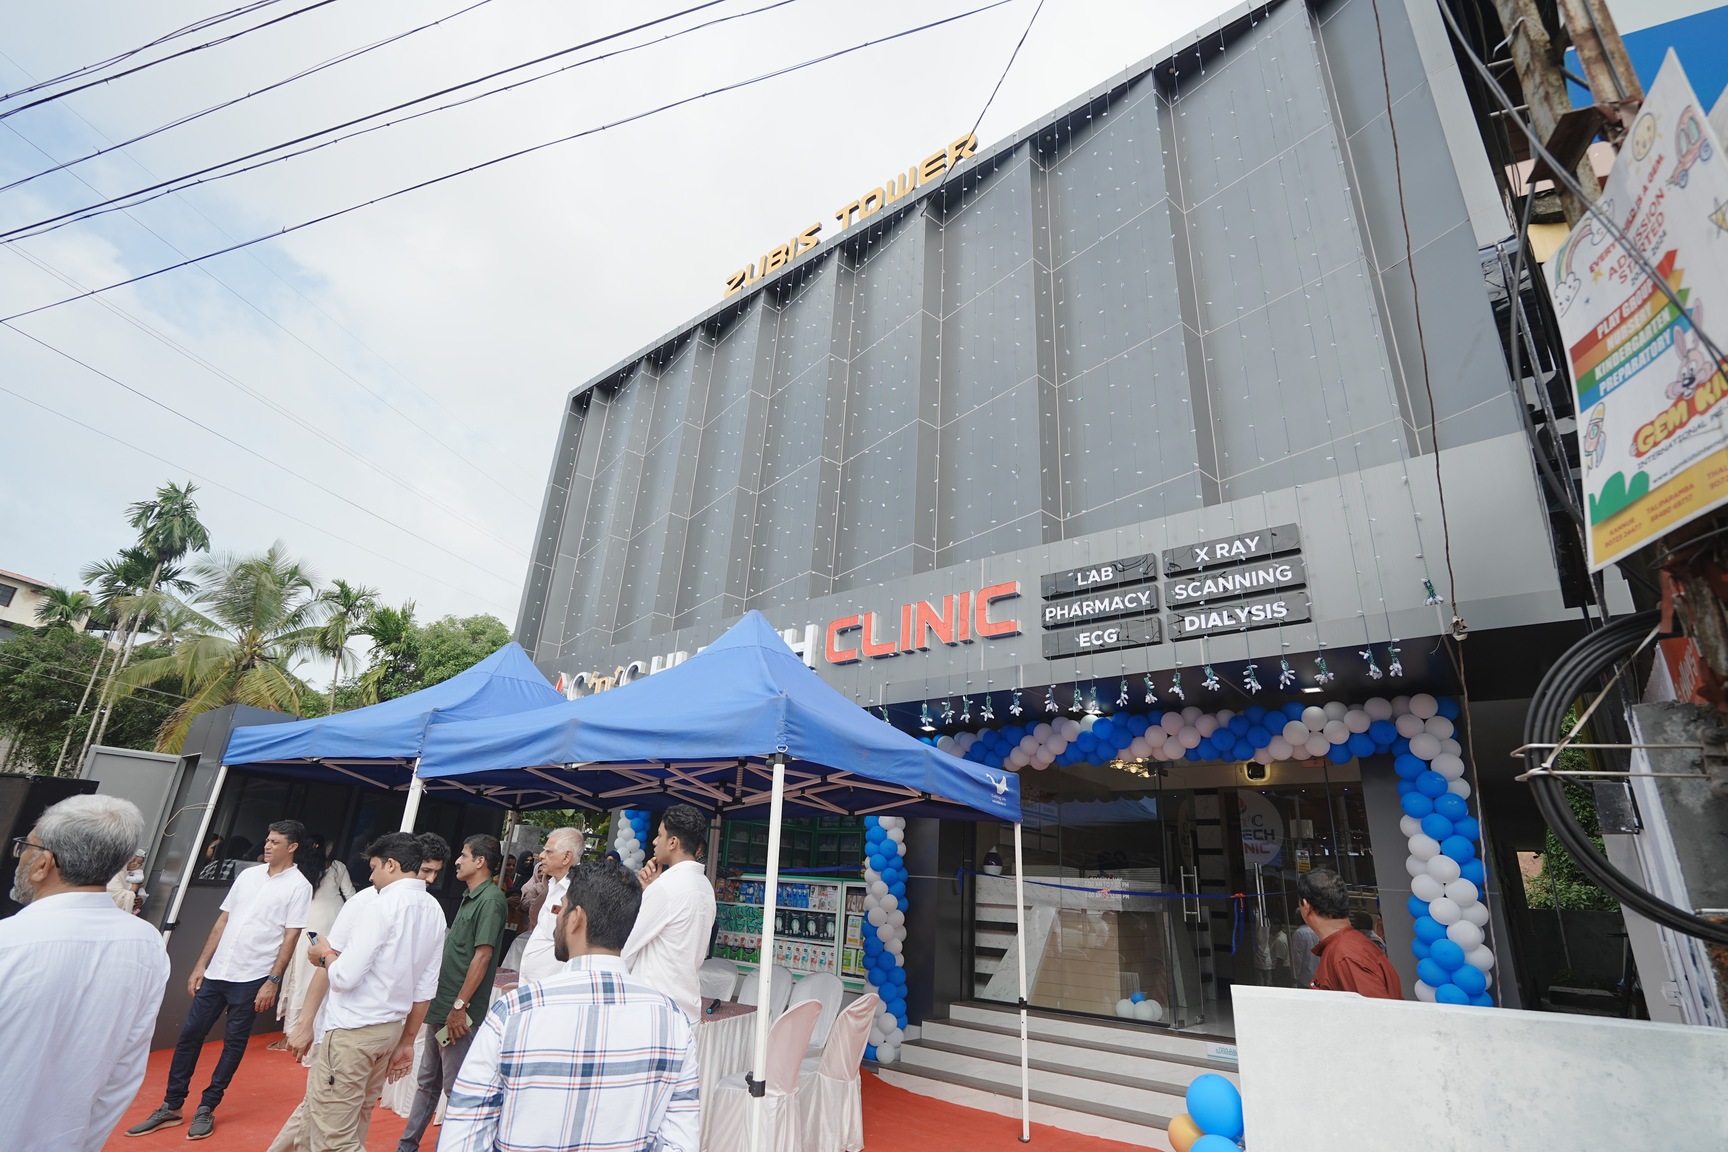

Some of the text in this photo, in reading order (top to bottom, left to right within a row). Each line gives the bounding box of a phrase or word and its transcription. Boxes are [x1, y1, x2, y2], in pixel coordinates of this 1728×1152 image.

[724, 132, 979, 299] ZUBIS TOWER
[1589, 239, 1616, 273] EVERY
[1648, 153, 1664, 183] GEM
[1597, 277, 1654, 340] PLAY GROUP
[1606, 301, 1652, 351] NURSERY
[1594, 306, 1671, 381] KINDERGARTEN
[1599, 327, 1671, 397] PREPARATORY
[1637, 400, 1689, 453] GEM
[1637, 421, 1707, 470] INTERNATIONAL
[1195, 536, 1260, 562] X RAY
[1077, 566, 1113, 586] LAB
[1174, 565, 1292, 600] SCANNING
[825, 580, 1022, 665] CLINIC
[1045, 591, 1150, 621] PHARMACY
[1184, 601, 1288, 632] DIALYSIS
[1078, 628, 1118, 647] ECG
[1242, 829, 1275, 840] ECH
